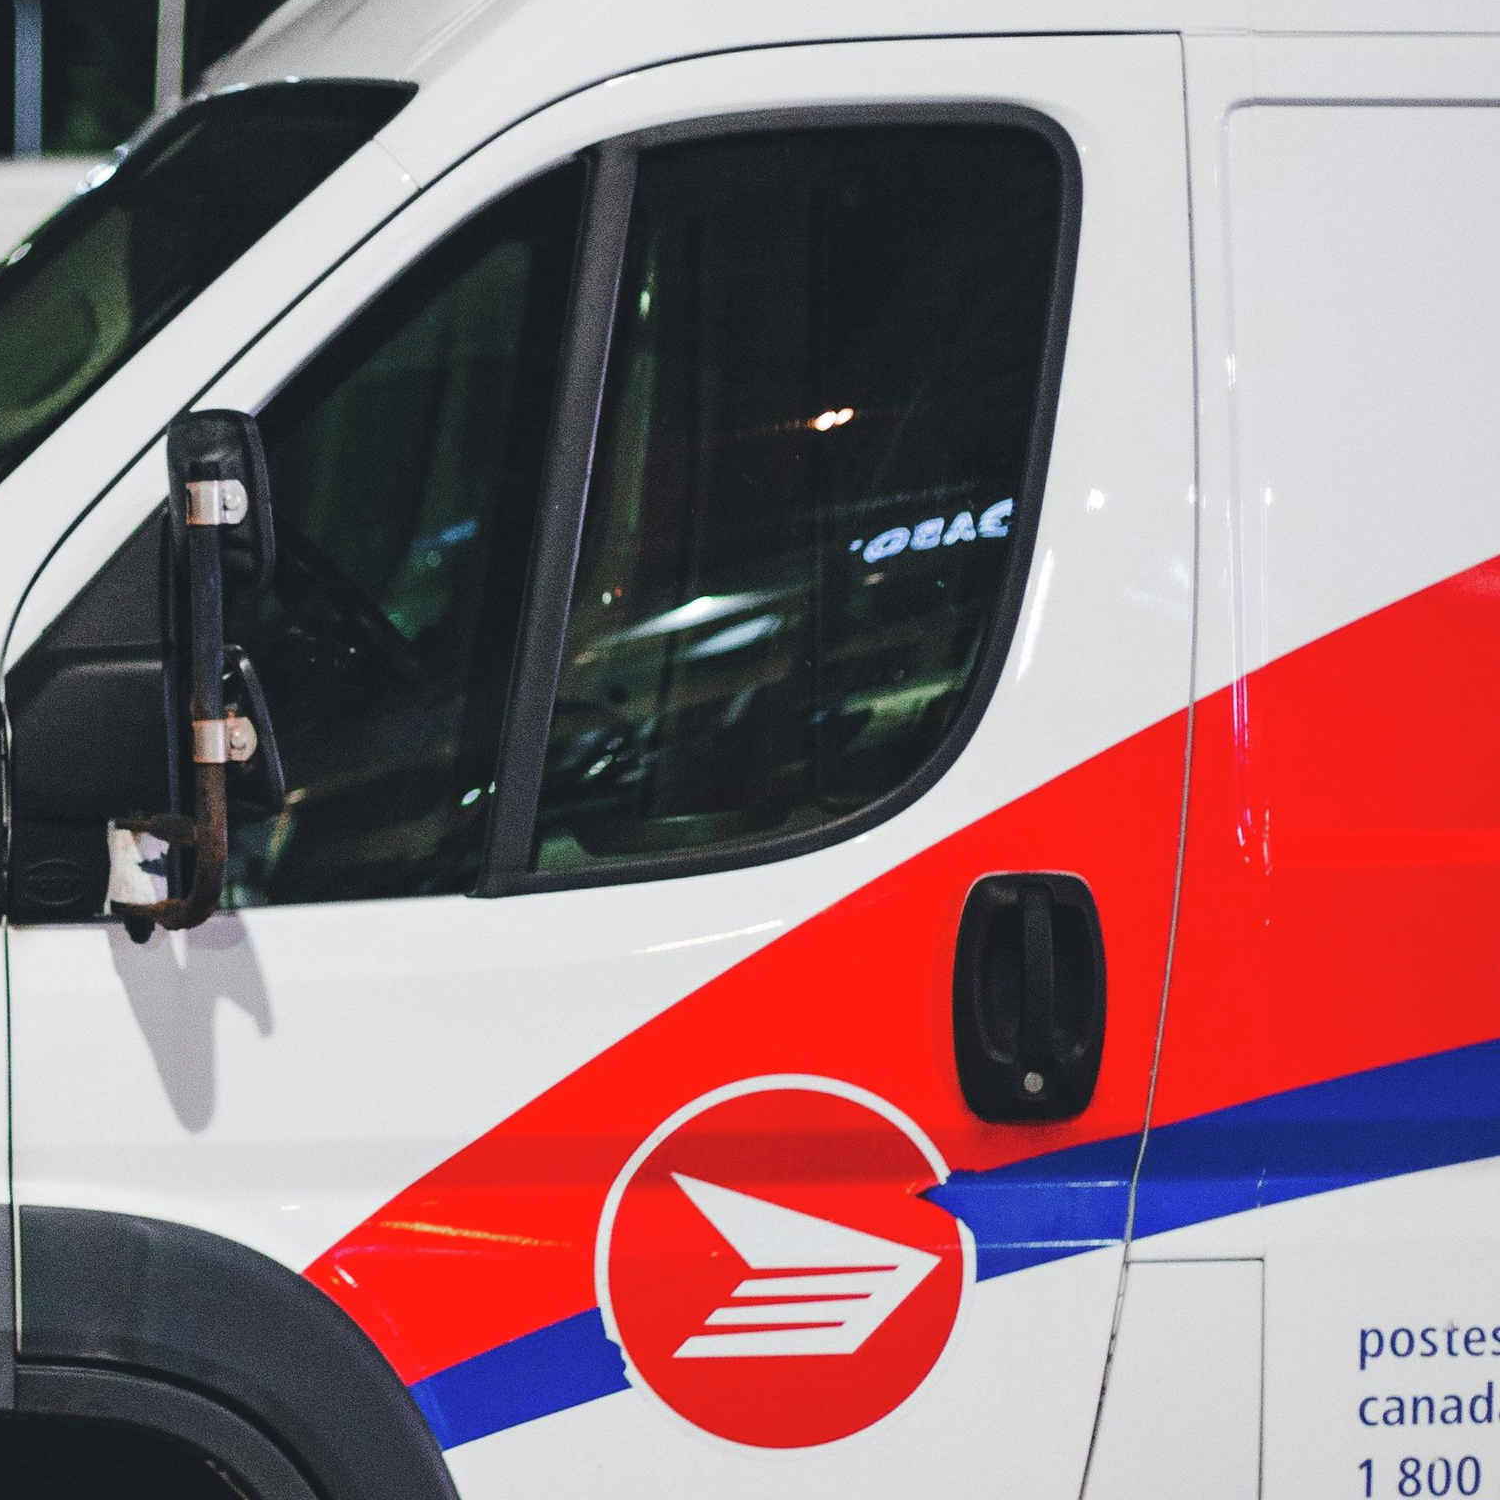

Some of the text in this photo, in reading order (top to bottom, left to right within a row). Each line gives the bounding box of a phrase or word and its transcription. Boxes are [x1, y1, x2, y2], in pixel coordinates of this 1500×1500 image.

[1358, 1380, 1500, 1427] canad
[1358, 1454, 1482, 1499] 1 800
